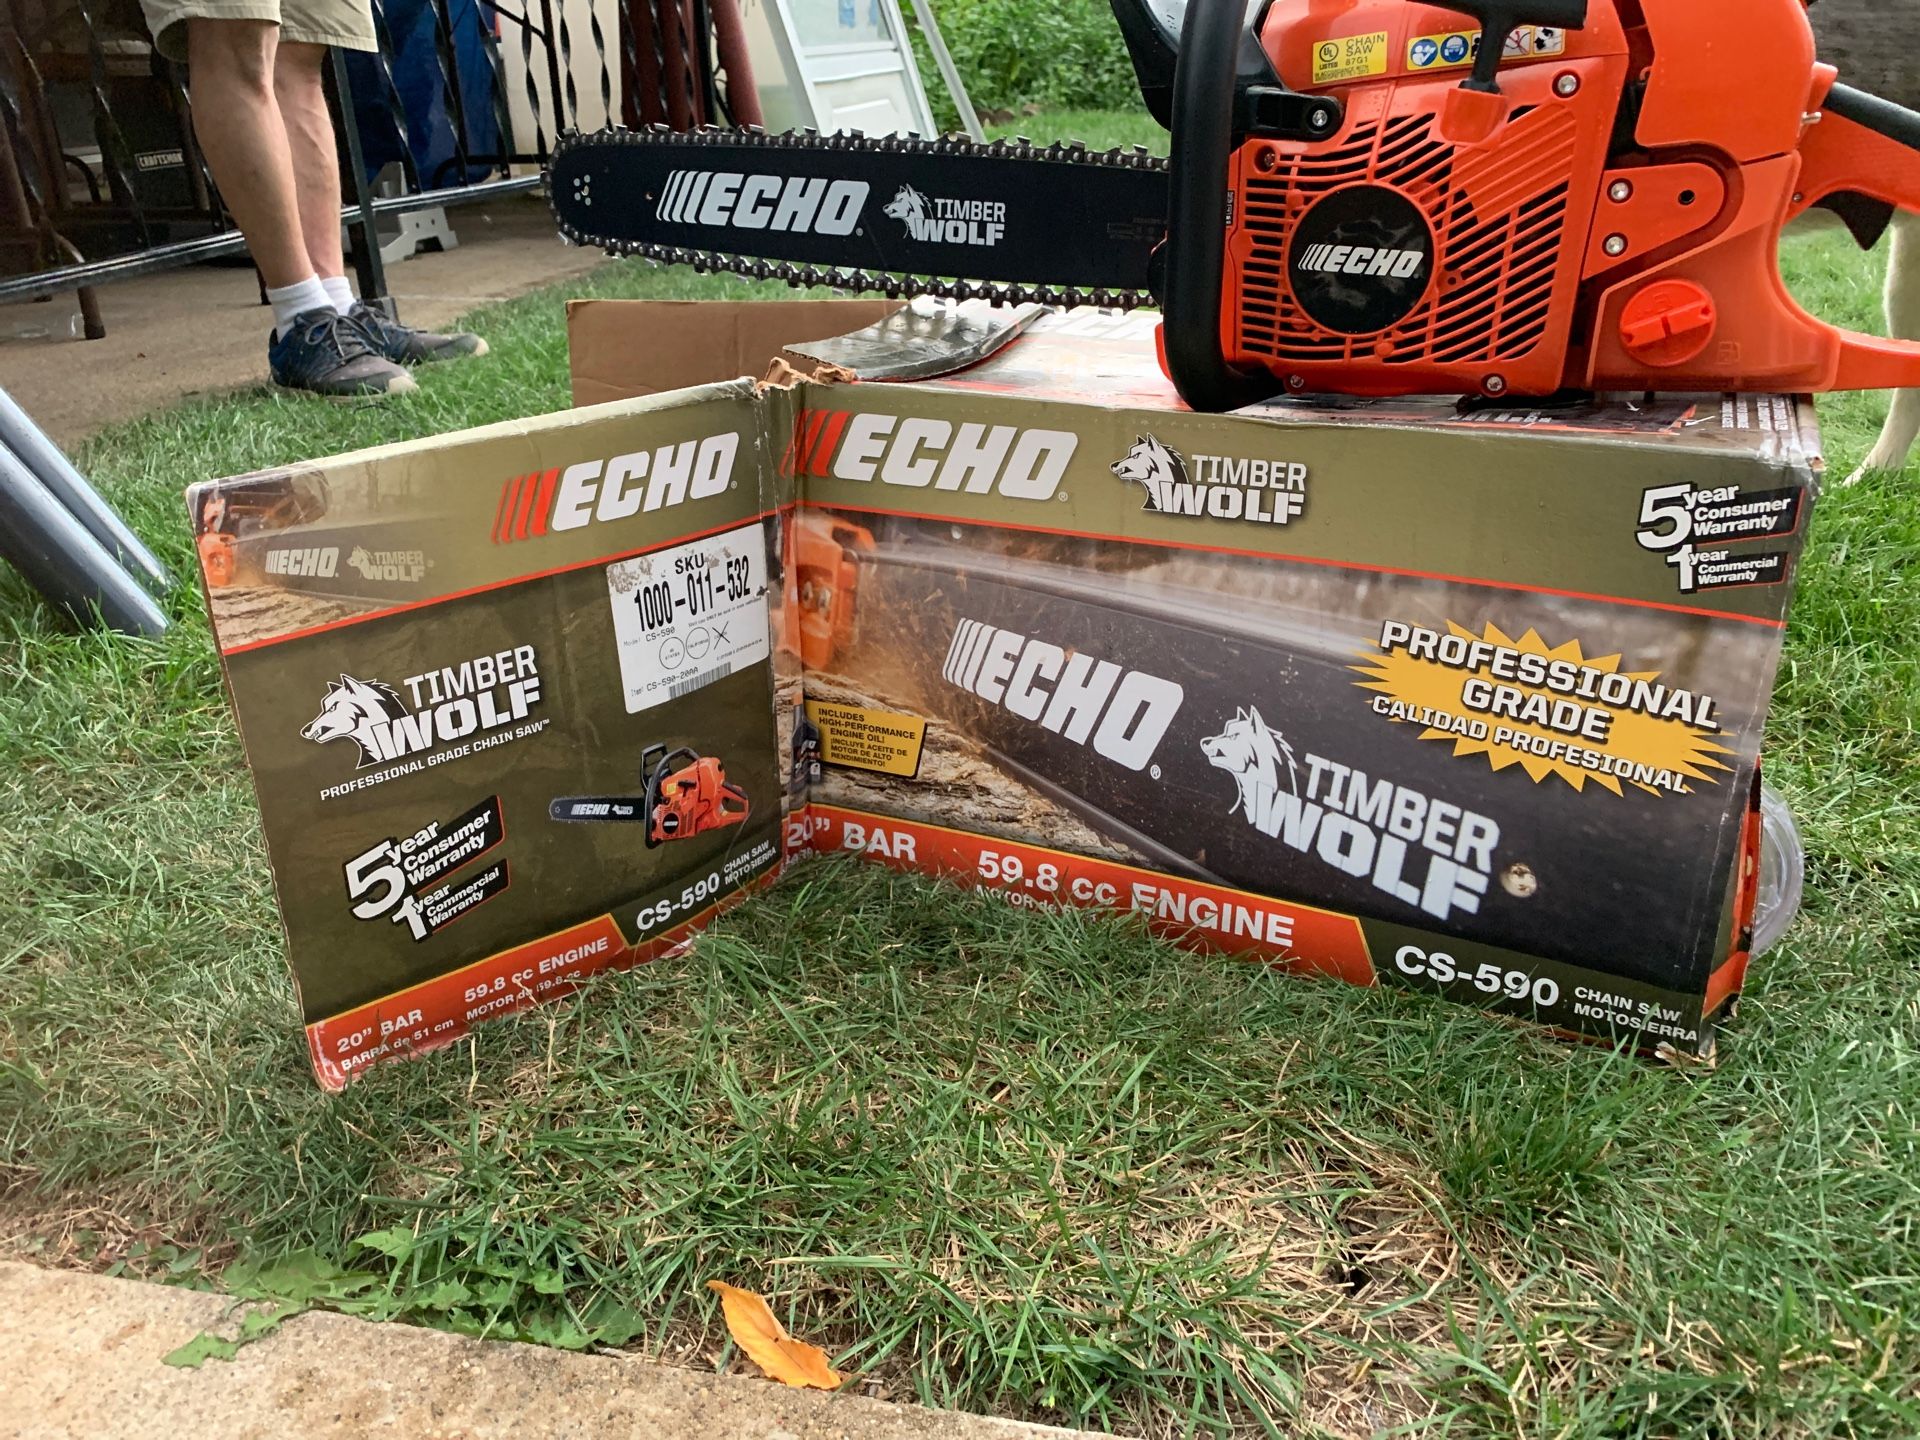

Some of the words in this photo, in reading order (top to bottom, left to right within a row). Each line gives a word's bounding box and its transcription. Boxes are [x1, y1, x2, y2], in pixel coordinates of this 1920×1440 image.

[1346, 34, 1385, 48] CHAIN
[1346, 44, 1374, 57] SAW
[699, 172, 870, 235] ECHO
[934, 198, 1006, 222] TIMBER
[916, 217, 1005, 246] WOLF
[1323, 245, 1424, 278] ECHO
[833, 413, 1078, 500] ECHO
[1191, 454, 1307, 492] TIMBER
[553, 431, 739, 532] ECHO
[1159, 480, 1305, 525] WOLF
[1637, 484, 1692, 549] 5
[1683, 485, 1740, 510] year
[1694, 498, 1791, 521] Consumer
[1694, 515, 1778, 537] Warranty
[278, 547, 340, 578] ECHO
[365, 564, 425, 582] WOLF
[373, 550, 425, 566] TIMBER
[675, 553, 705, 575] SKU
[1666, 544, 1693, 590] 1
[1689, 550, 1729, 566] year
[1697, 570, 1758, 585] Warranty
[1698, 556, 1778, 575] Commercial
[634, 555, 750, 632] 1000-011-532
[645, 626, 676, 642] CS-590
[403, 644, 538, 709] TIMBER
[1380, 619, 1719, 730] PROFESSIONAL
[371, 676, 541, 761] WOLF
[818, 707, 865, 722] INCLUDES
[975, 628, 1184, 772] ECHO
[1462, 677, 1612, 740] GRADE
[818, 716, 916, 739] HIGH-PERFORMANCE
[830, 728, 865, 740] ENGINE
[866, 743, 895, 754] ACEITE
[896, 748, 908, 757] DE
[1372, 695, 1488, 740] CALIDAD
[1493, 725, 1689, 794] PROFESIONAL
[320, 759, 426, 801] PROFESSIONAL
[427, 744, 472, 767] GRADE
[472, 730, 514, 752] CHAIN
[830, 744, 858, 755] MOTOR
[860, 748, 871, 758] DE
[872, 751, 892, 761] ALTO
[1304, 752, 1500, 874] TIMBER
[403, 809, 491, 872] Consumer
[406, 831, 485, 886] Warranty
[723, 851, 750, 874] CHAIN
[751, 839, 769, 857] SAW
[1255, 780, 1489, 922] WOLF
[345, 840, 406, 919] 5
[385, 821, 439, 866] year
[724, 847, 777, 885] MOTOSIERRA
[843, 821, 916, 862] BAR
[977, 850, 1059, 893] 59.8
[1072, 876, 1117, 906] cc
[1131, 881, 1295, 948] ENGINE
[391, 894, 427, 940] 1
[412, 884, 451, 914] year
[426, 867, 499, 918] Commercial
[428, 889, 484, 927] Warranty
[636, 872, 720, 930] CS-590
[380, 1009, 423, 1036] BAR
[464, 976, 506, 1003] 59.8
[511, 968, 534, 984] cc
[538, 936, 609, 975] ENGINE
[1395, 945, 1560, 1007] CS-590
[466, 993, 515, 1020] MOTOR
[517, 987, 533, 1000] de
[1574, 986, 1633, 1011] CHAIN
[1637, 1001, 1681, 1022] SAW
[340, 1044, 390, 1071] BARRA
[393, 1037, 410, 1049] de
[414, 1027, 430, 1040] 51
[434, 1018, 455, 1032] cm
